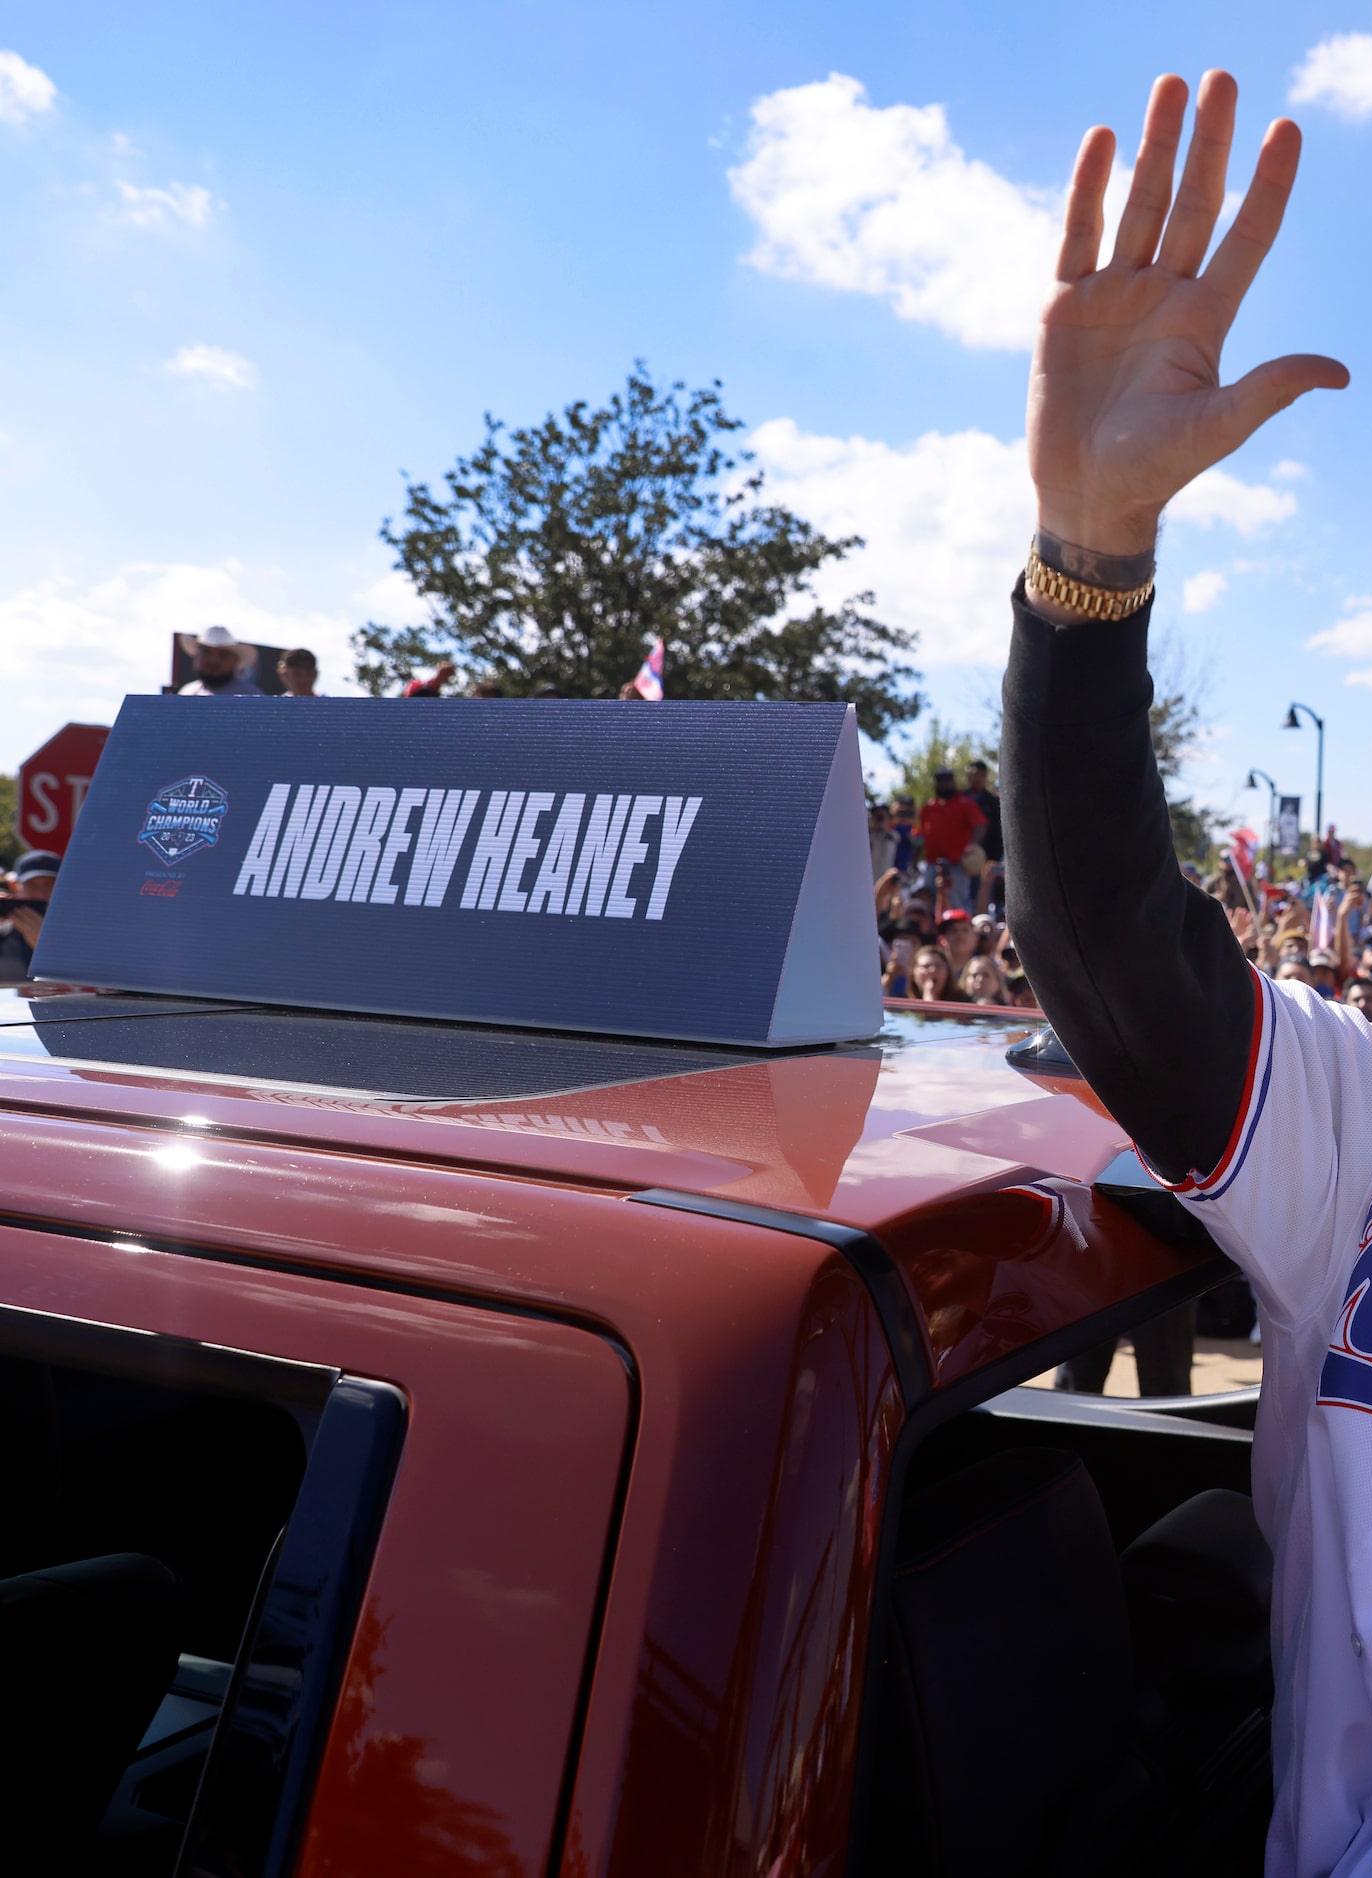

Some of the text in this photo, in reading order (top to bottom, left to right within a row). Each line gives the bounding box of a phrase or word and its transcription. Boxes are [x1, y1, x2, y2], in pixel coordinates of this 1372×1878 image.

[168, 798, 210, 814] WORLD
[146, 816, 218, 833] CHAMPIONS
[232, 784, 704, 921] ANDREW HEANEY
